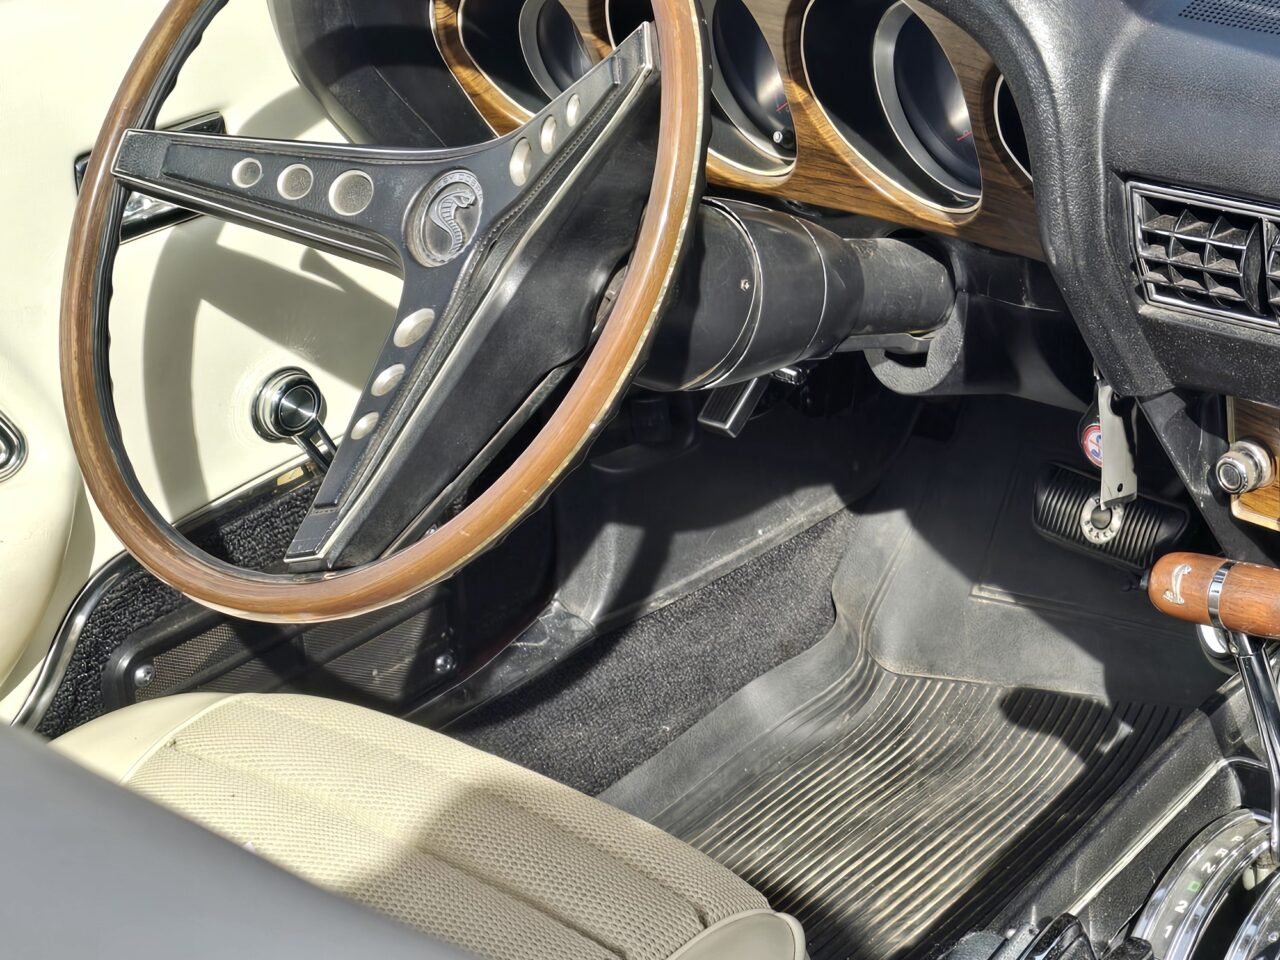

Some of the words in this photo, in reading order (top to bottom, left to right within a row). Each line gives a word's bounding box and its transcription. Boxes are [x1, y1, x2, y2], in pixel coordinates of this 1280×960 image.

[1215, 848, 1228, 858] R
[1201, 862, 1216, 874] N
[1175, 900, 1188, 914] 2
[1164, 924, 1174, 939] 1
